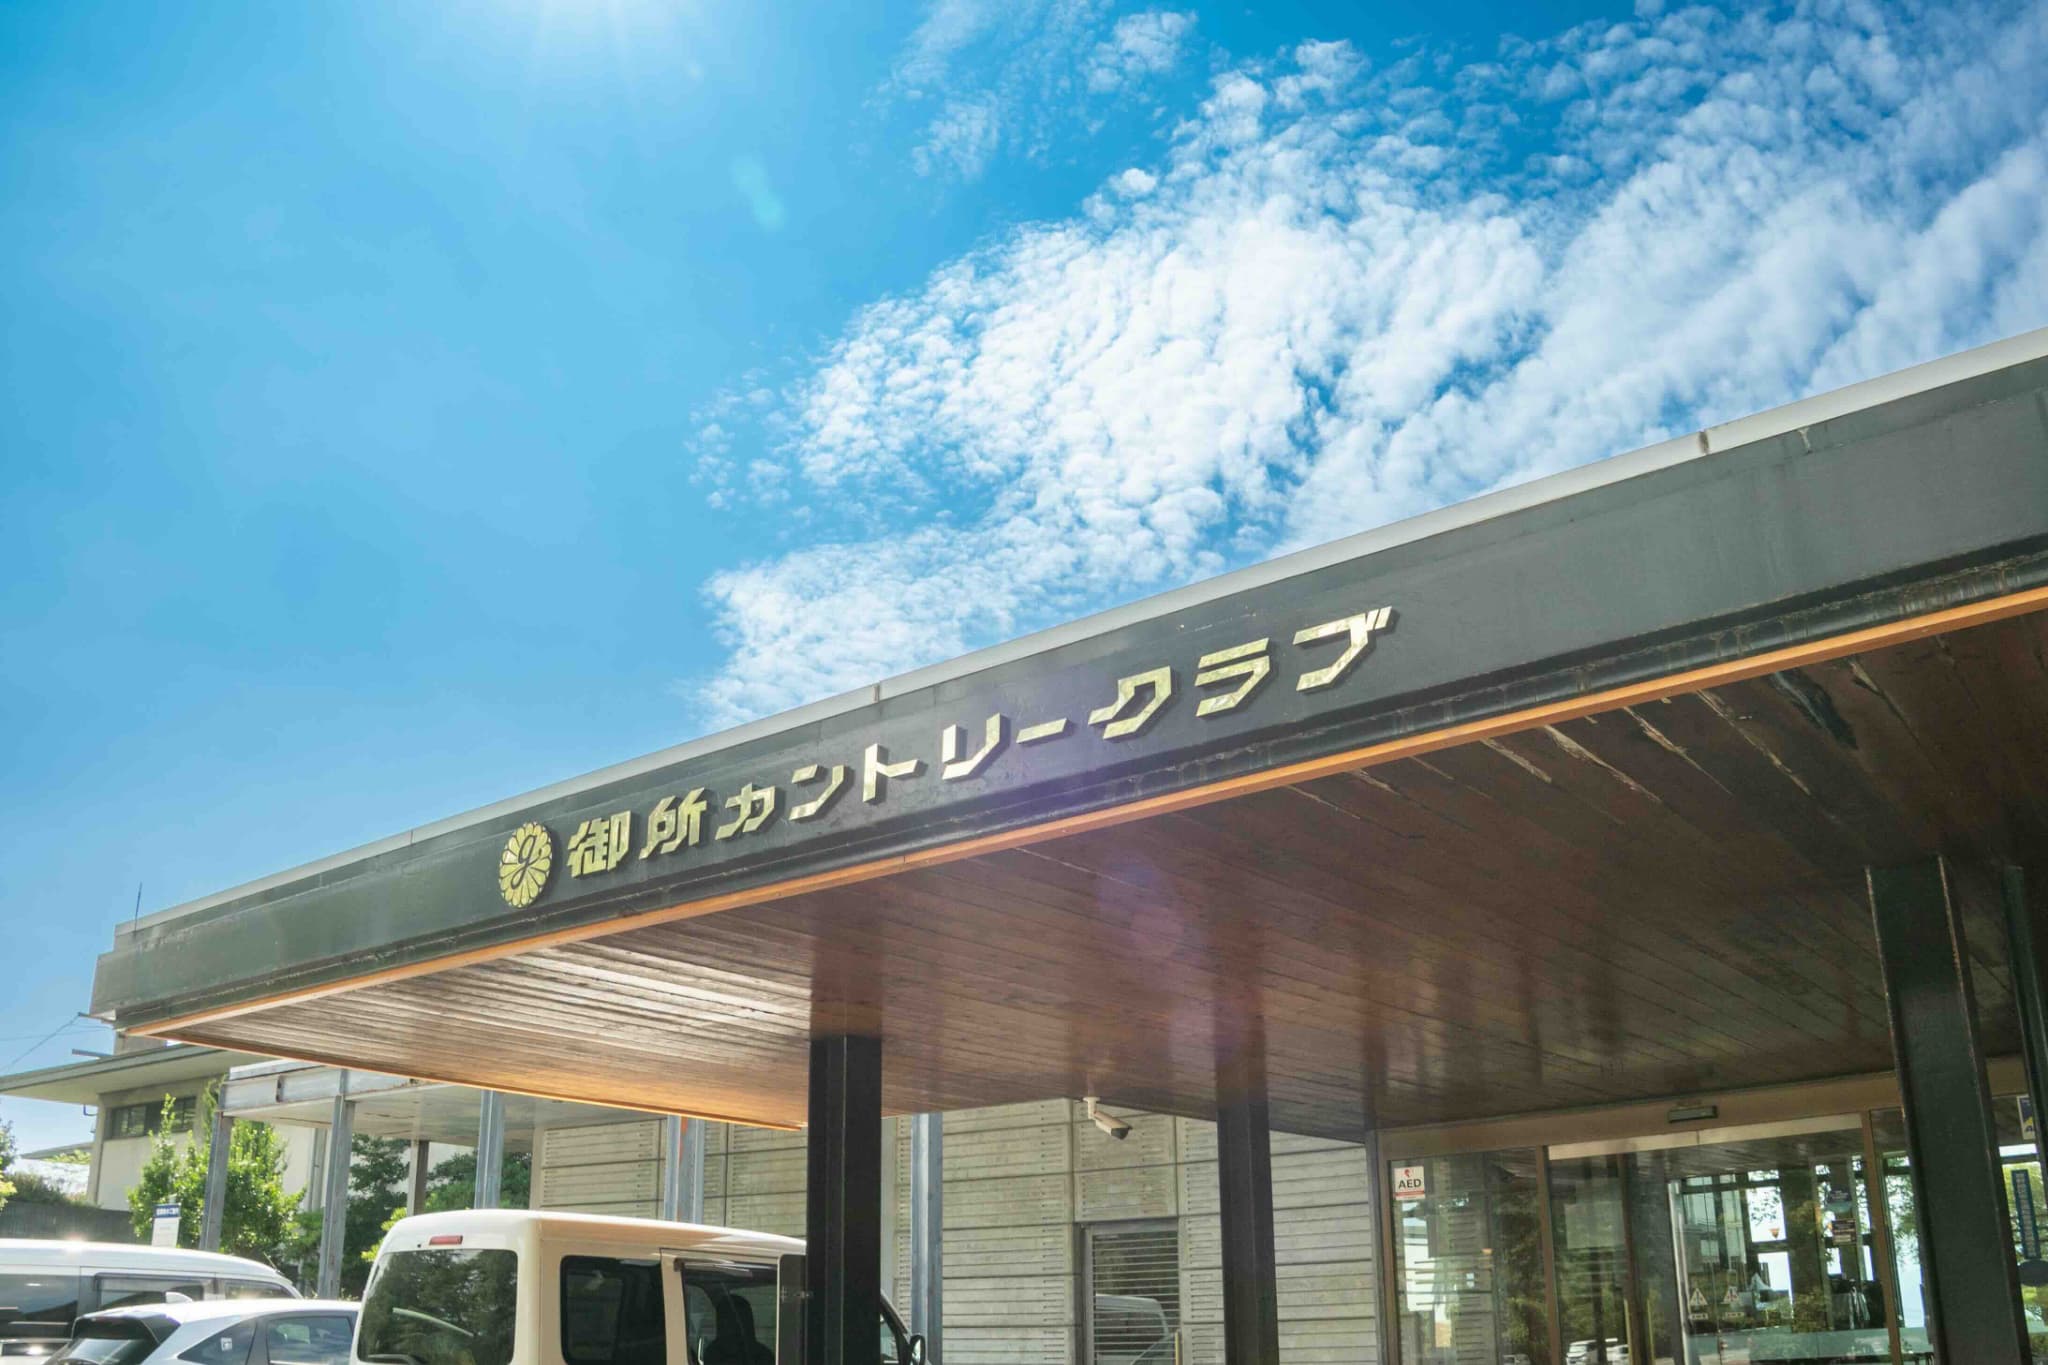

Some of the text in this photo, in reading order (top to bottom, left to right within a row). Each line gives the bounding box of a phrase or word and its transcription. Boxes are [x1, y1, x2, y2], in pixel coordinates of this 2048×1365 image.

[566, 606, 1393, 879] 御所カントリークラブ
[1398, 1178, 1422, 1189] AED
